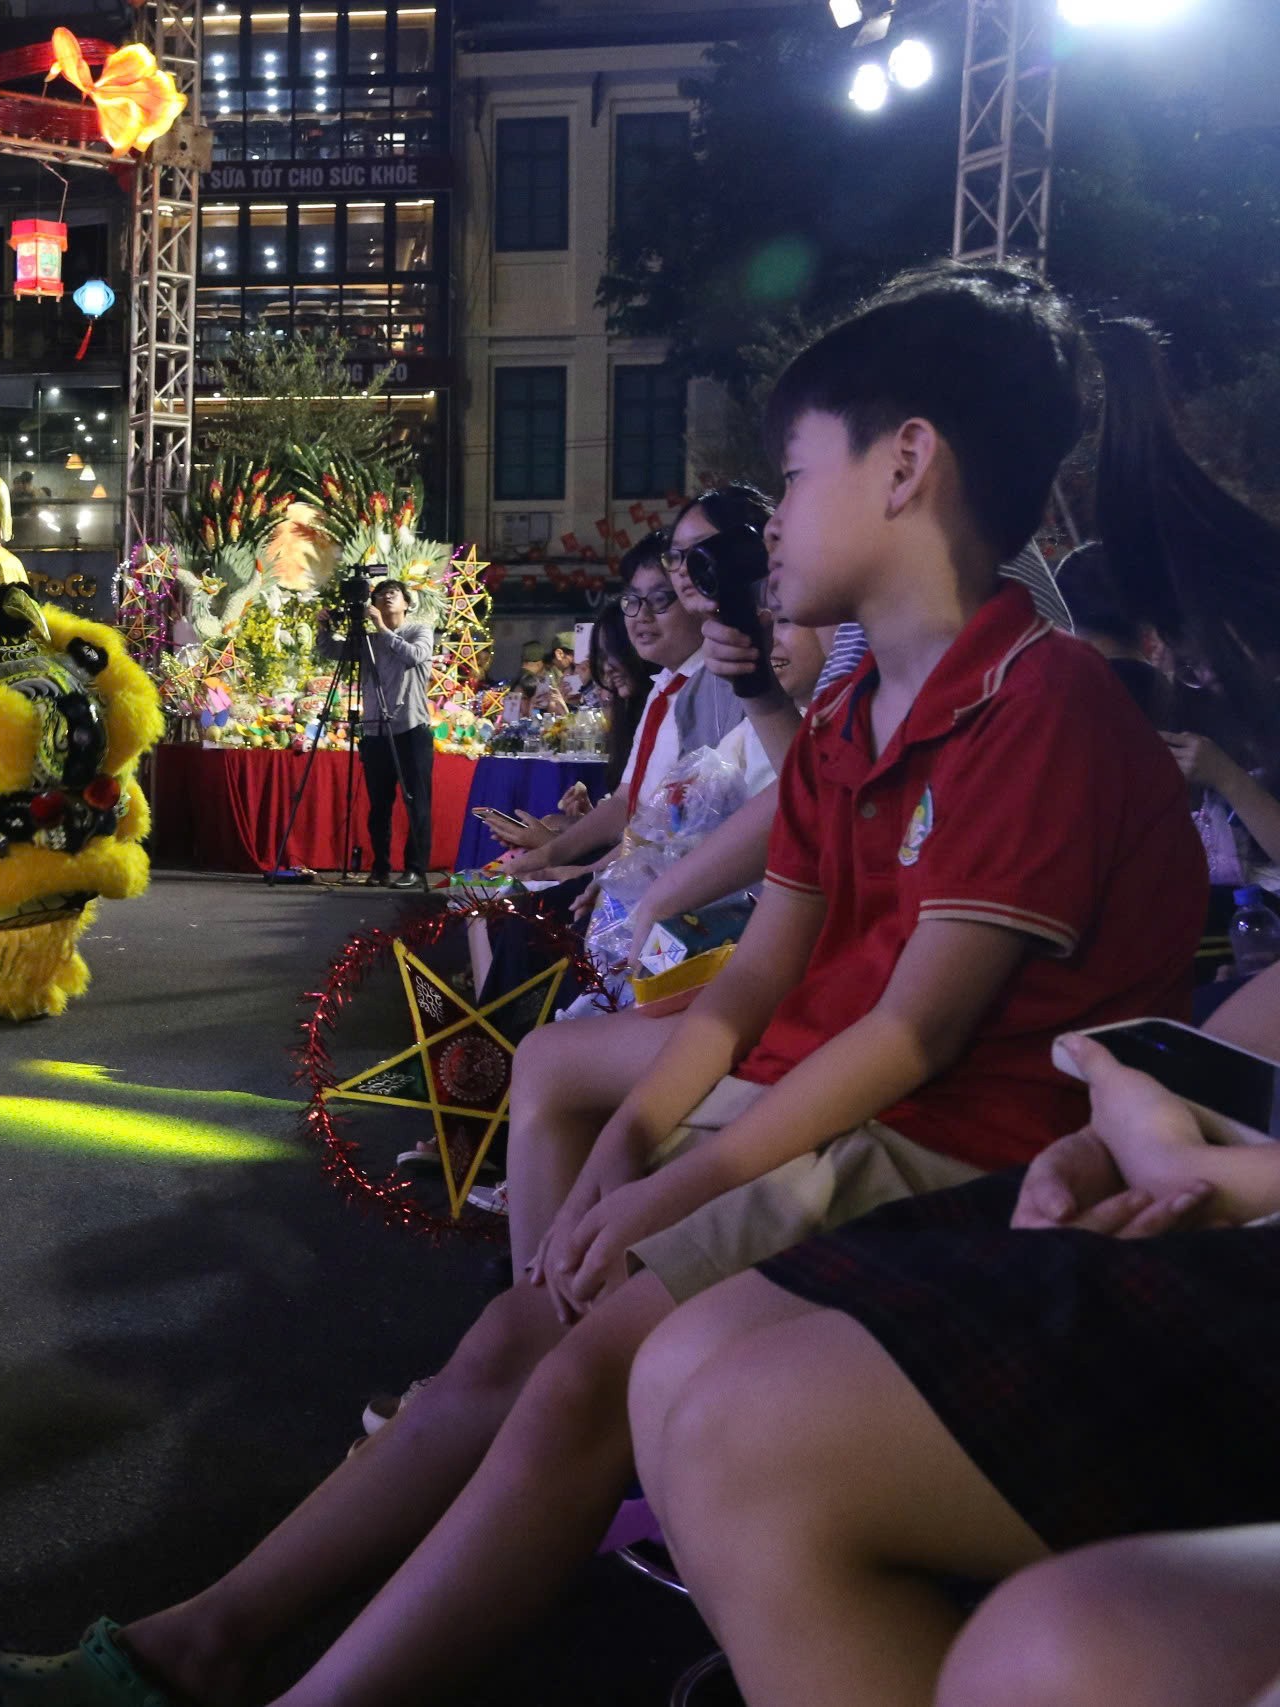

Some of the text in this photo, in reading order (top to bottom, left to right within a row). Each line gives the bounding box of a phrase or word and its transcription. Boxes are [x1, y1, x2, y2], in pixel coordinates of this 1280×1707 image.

[251, 162, 284, 188] TỐT
[288, 168, 324, 188] CHO
[329, 163, 366, 186] SỨC
